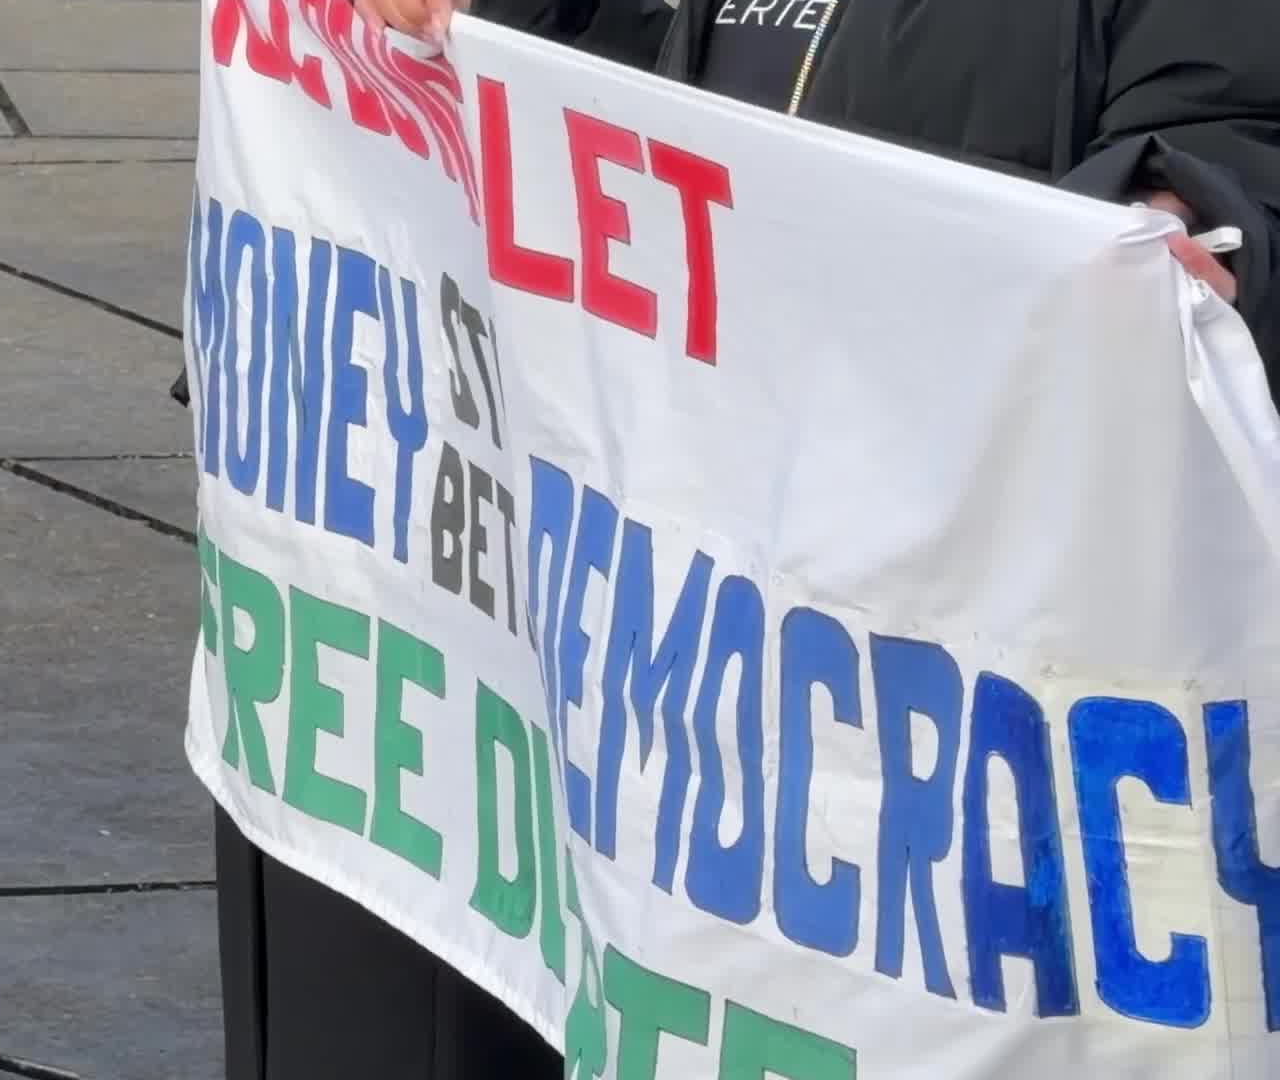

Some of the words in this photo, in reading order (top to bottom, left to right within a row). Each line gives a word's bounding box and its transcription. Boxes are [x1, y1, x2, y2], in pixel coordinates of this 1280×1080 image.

[476, 74, 734, 367] LET
[192, 182, 429, 565] MONEY
[440, 271, 507, 450] ST
[430, 440, 520, 638] BET
